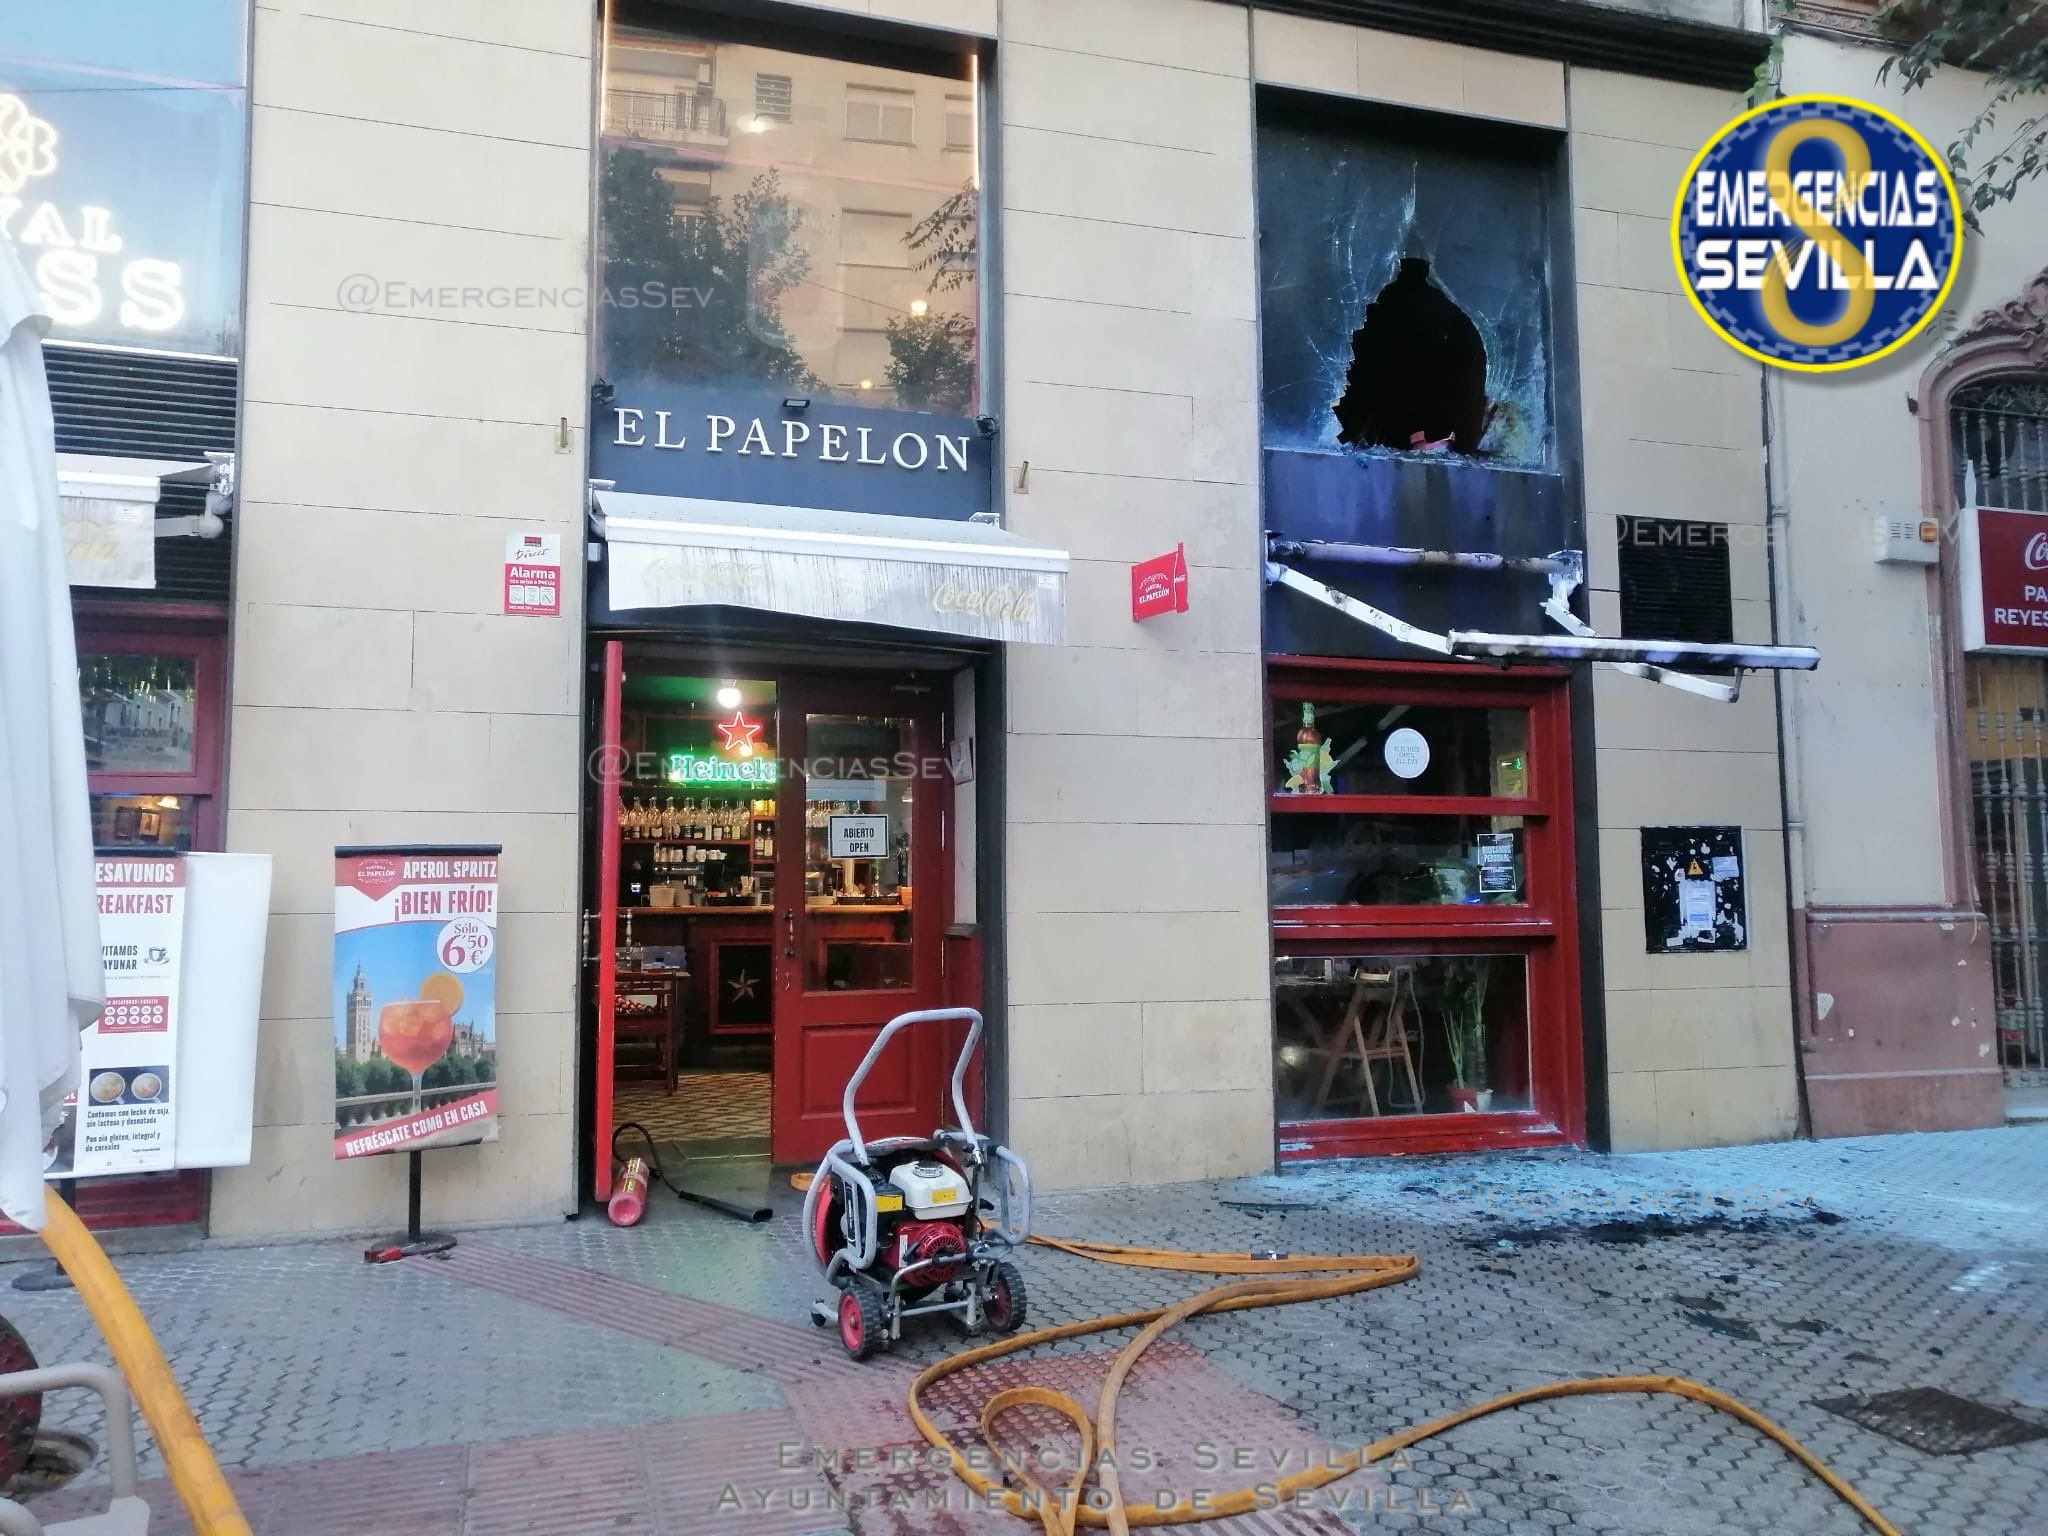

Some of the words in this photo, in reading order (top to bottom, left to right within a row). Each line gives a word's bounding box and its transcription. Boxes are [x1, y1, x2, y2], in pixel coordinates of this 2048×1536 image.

[613, 407, 687, 450] EL
[705, 414, 970, 472] PAPELON
[509, 566, 556, 580] Alarma
[843, 827, 875, 839] ABIERTO
[849, 842, 869, 853] OPEN
[95, 862, 175, 883] ESAYUNOS
[403, 861, 451, 879] APEROL
[453, 861, 497, 878] SPRITZ
[394, 890, 441, 921] ¡BIEN
[448, 885, 493, 914] FRÍO!
[454, 923, 479, 935] Sólo
[87, 1110, 117, 1119] Contamos
[130, 1108, 147, 1117] leche
[98, 1118, 120, 1127] lactosa
[121, 1119, 125, 1127] y
[126, 1117, 157, 1126] desnatada
[345, 1124, 411, 1157] REFRÉSCATE
[412, 1114, 443, 1137] COMO
[445, 1111, 459, 1126] EN
[460, 1100, 488, 1121] CASA
[86, 1135, 97, 1143] Pan
[132, 1131, 156, 1141] integral
[156, 1132, 161, 1140] y
[85, 1144, 93, 1152] de
[94, 1143, 120, 1152] cereales
